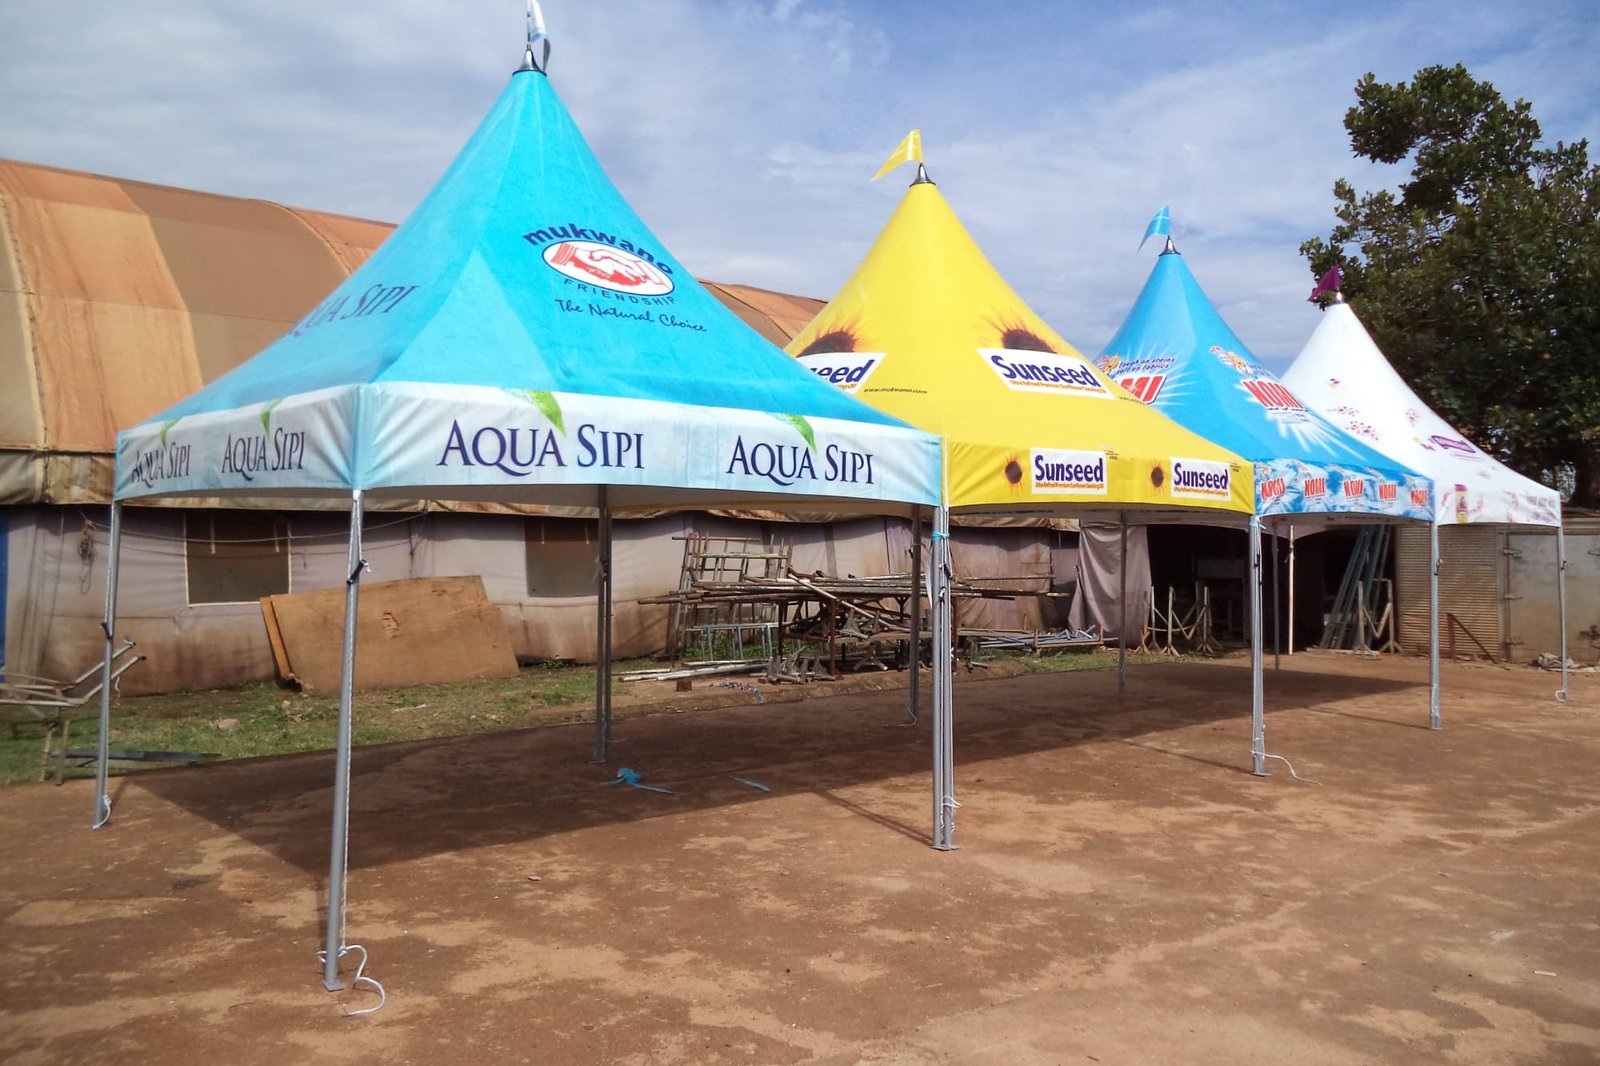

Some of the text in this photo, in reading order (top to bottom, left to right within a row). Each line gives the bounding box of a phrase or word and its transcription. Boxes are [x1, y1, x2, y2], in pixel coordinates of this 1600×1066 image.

[522, 223, 674, 275] mukwano
[340, 283, 421, 320] SIPI
[563, 278, 676, 306] FRIENDSHIP
[554, 298, 708, 332] The Natural Choice
[809, 359, 875, 384] eed
[990, 355, 1102, 388] Sunseed
[1242, 380, 1304, 409] NOMI
[220, 426, 305, 481] AQUA SIPI
[436, 419, 645, 477] AQUA SIPI
[725, 434, 876, 487] AQUA SIPI
[130, 441, 192, 489] AQUA SIPI
[1034, 454, 1104, 482] Sunseed
[1174, 462, 1228, 490] Sunseed
[1304, 477, 1325, 497] NOMI
